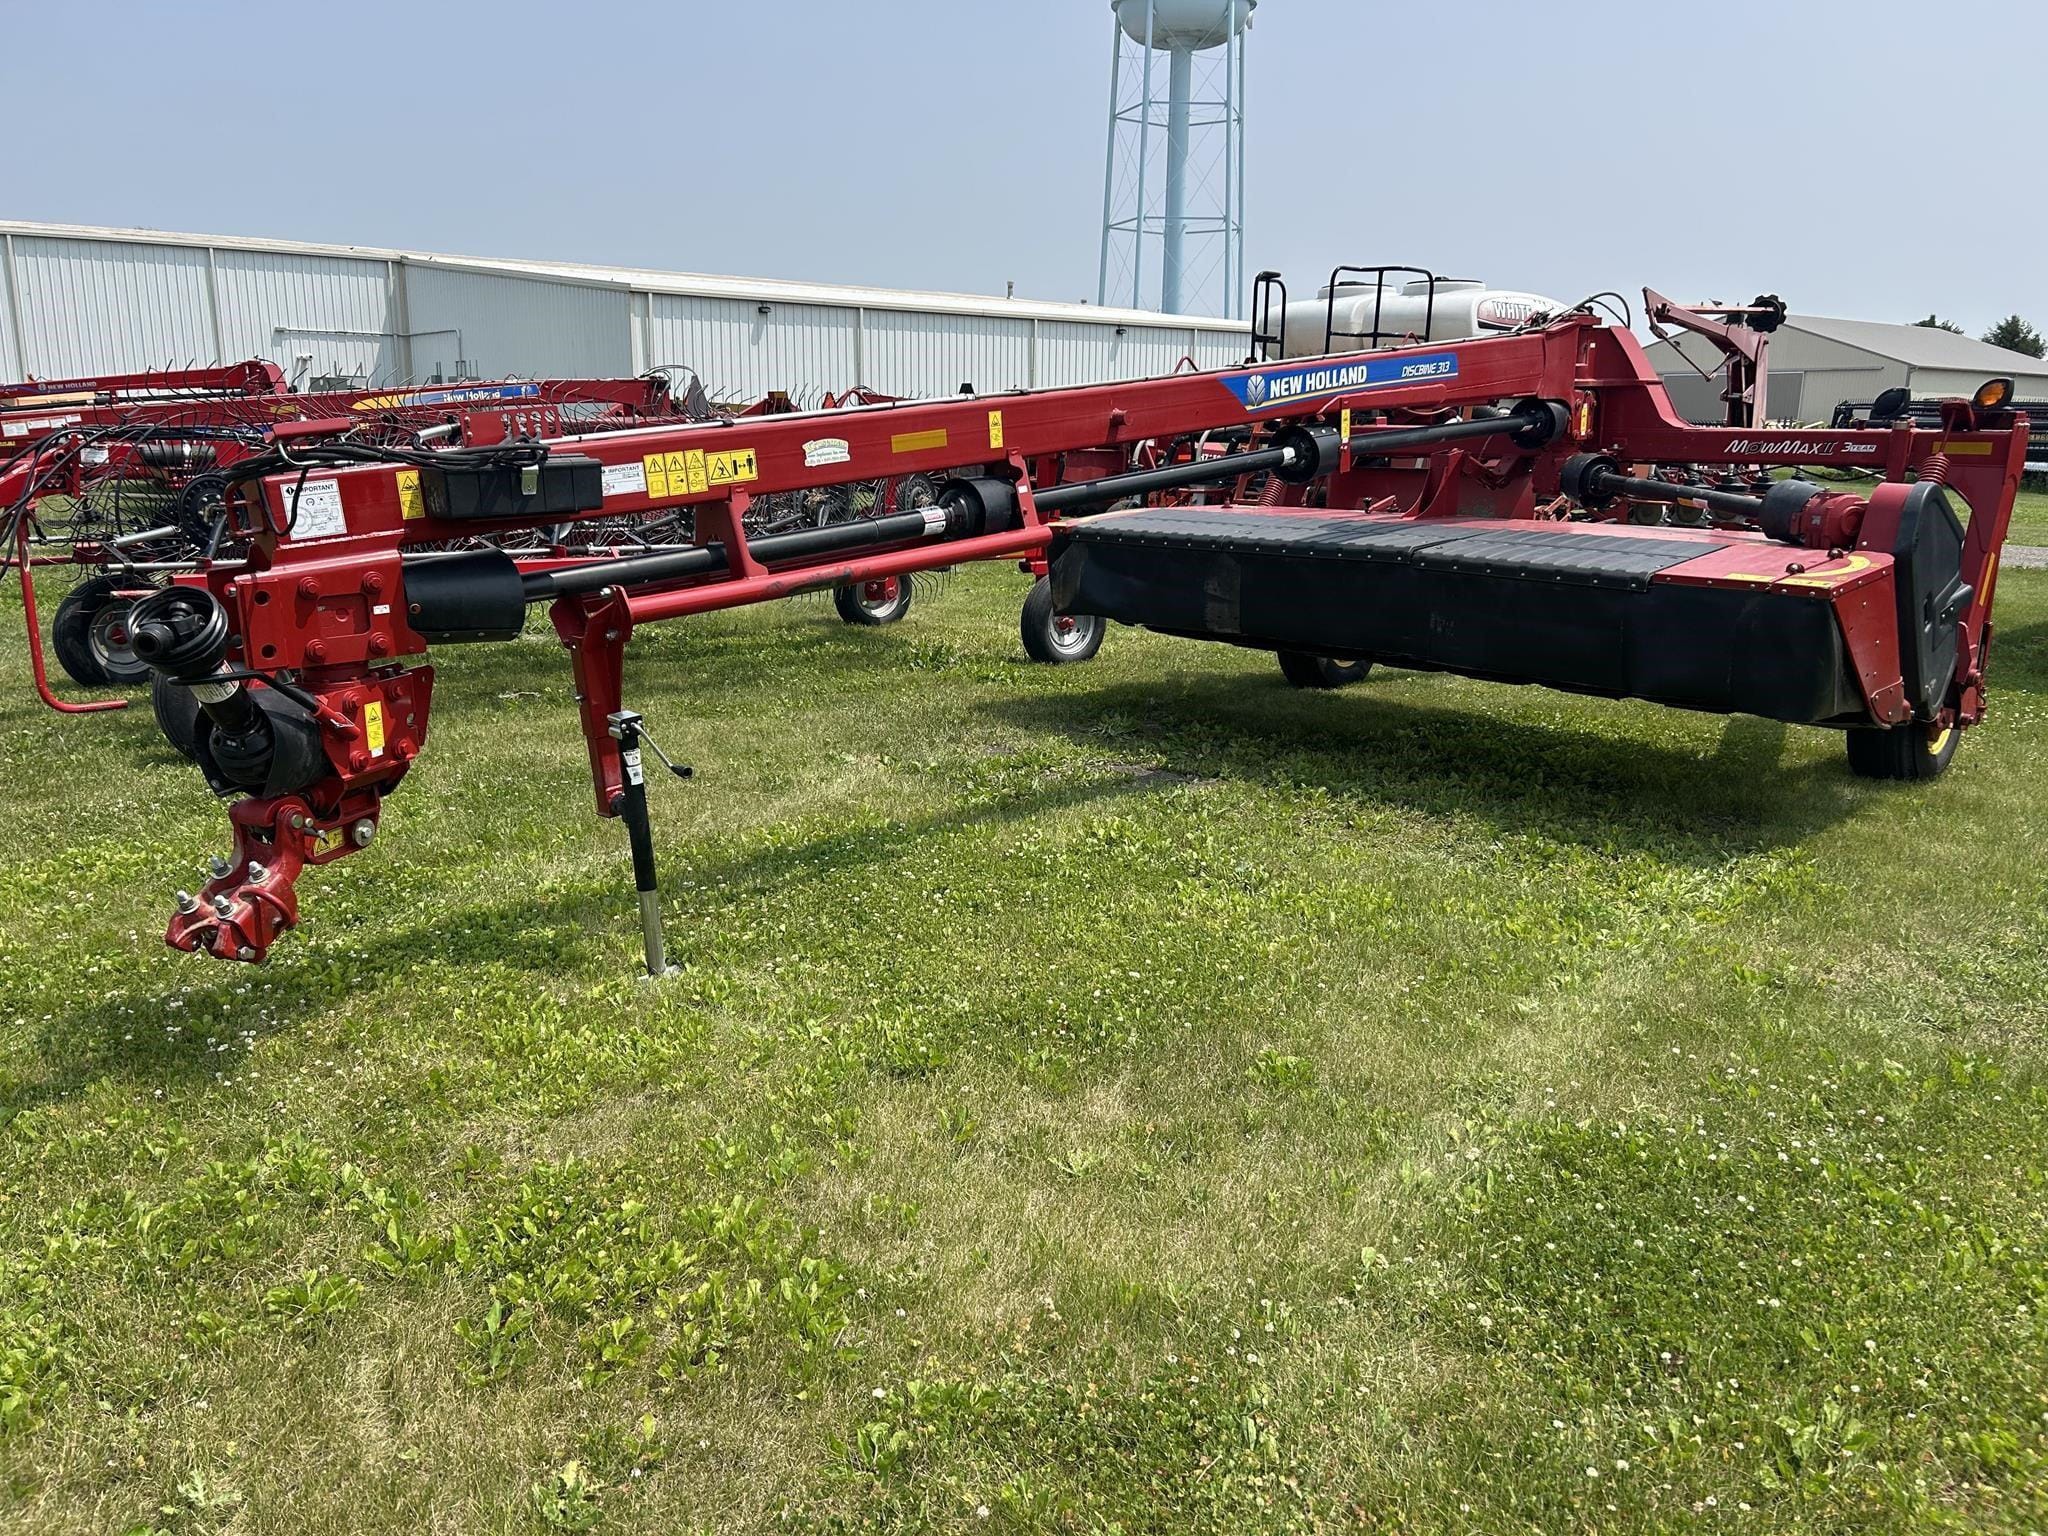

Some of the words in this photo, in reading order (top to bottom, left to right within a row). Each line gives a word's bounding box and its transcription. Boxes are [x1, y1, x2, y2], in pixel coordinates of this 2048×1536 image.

[1401, 363, 1436, 377] DISCBINE
[1436, 361, 1450, 374] 313
[47, 383, 64, 391] NEW
[65, 381, 97, 390] HOLLAND
[1269, 376, 1302, 399] NEW
[1305, 365, 1367, 392] HOLLAND
[607, 465, 640, 474] IMPORTANT
[300, 483, 334, 493] PORTANT
